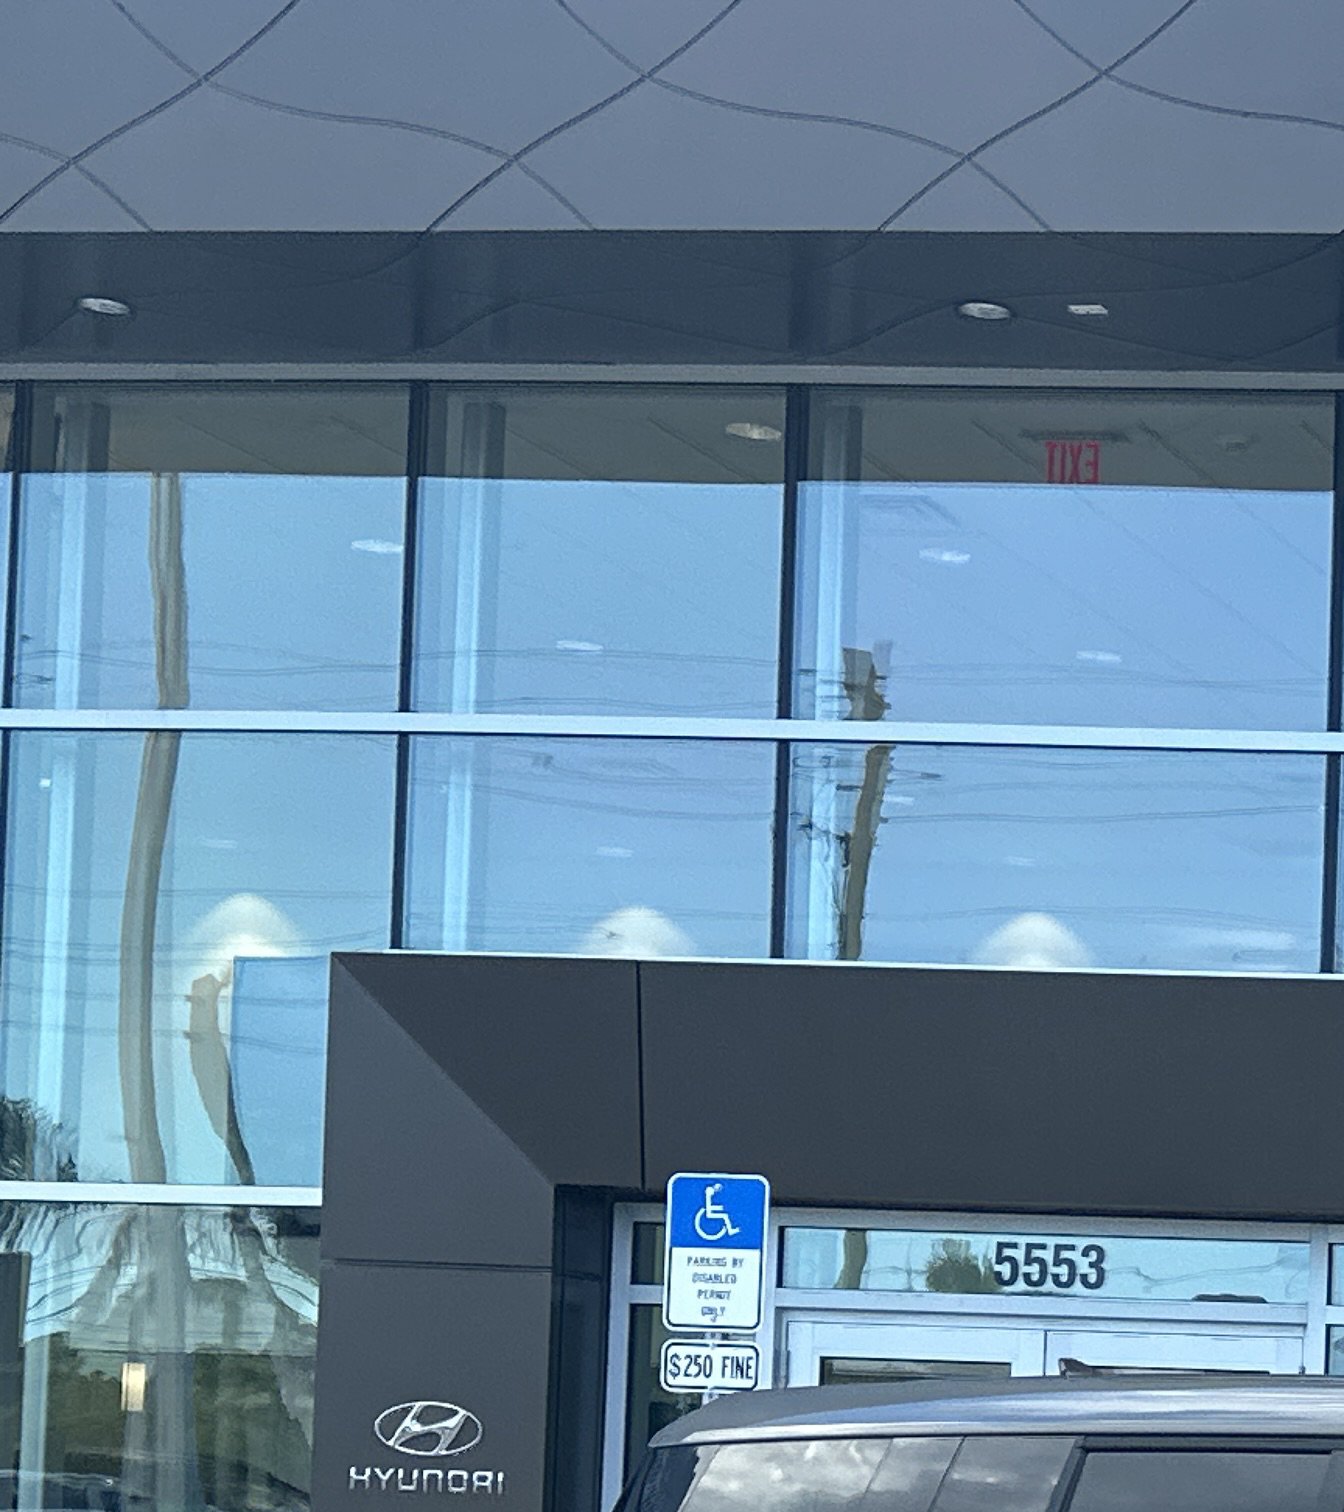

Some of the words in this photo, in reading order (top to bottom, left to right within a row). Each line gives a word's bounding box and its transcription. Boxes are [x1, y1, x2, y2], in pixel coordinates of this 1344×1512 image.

[994, 1241, 1105, 1290] 5553
[668, 1352, 713, 1381] $250
[721, 1354, 754, 1381] FINE
[349, 1466, 504, 1495] HYUNDAI
